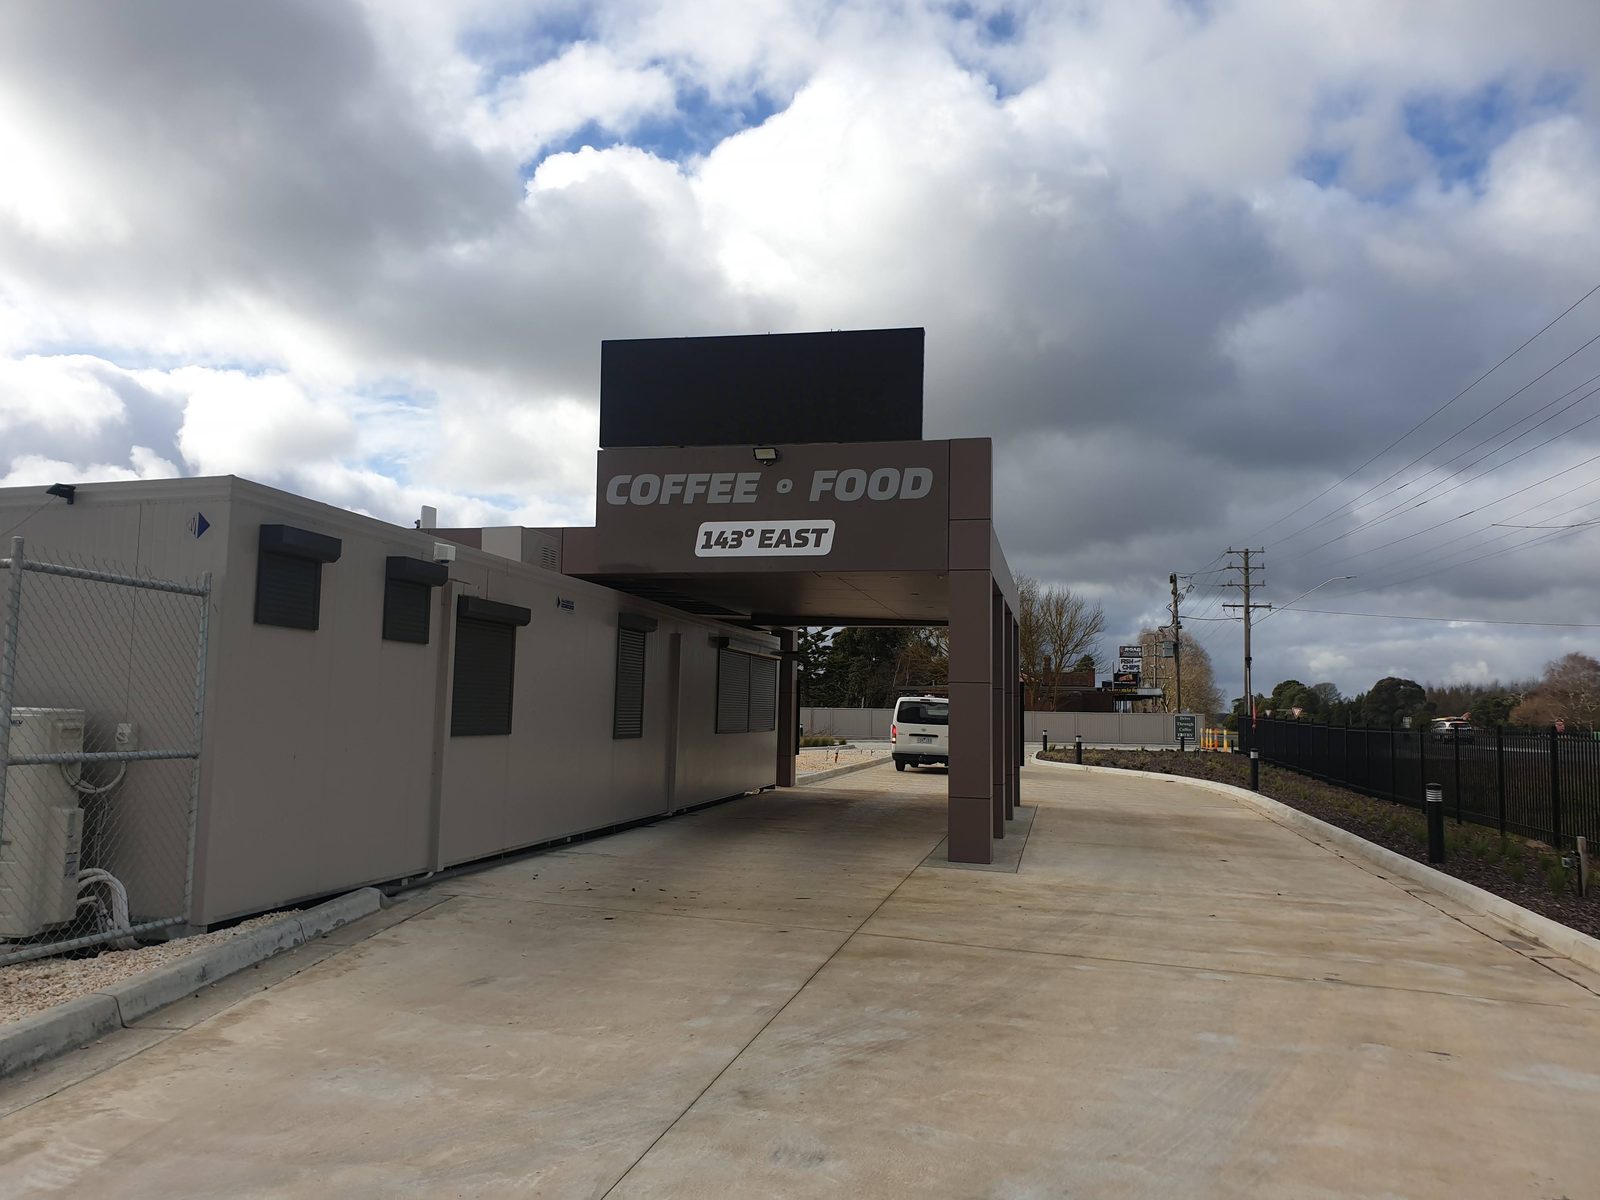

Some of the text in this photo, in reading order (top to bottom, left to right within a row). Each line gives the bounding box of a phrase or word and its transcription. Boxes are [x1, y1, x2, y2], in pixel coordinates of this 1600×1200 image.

[606, 467, 934, 505] COFFEE FOOD
[757, 527, 830, 549] EAST
